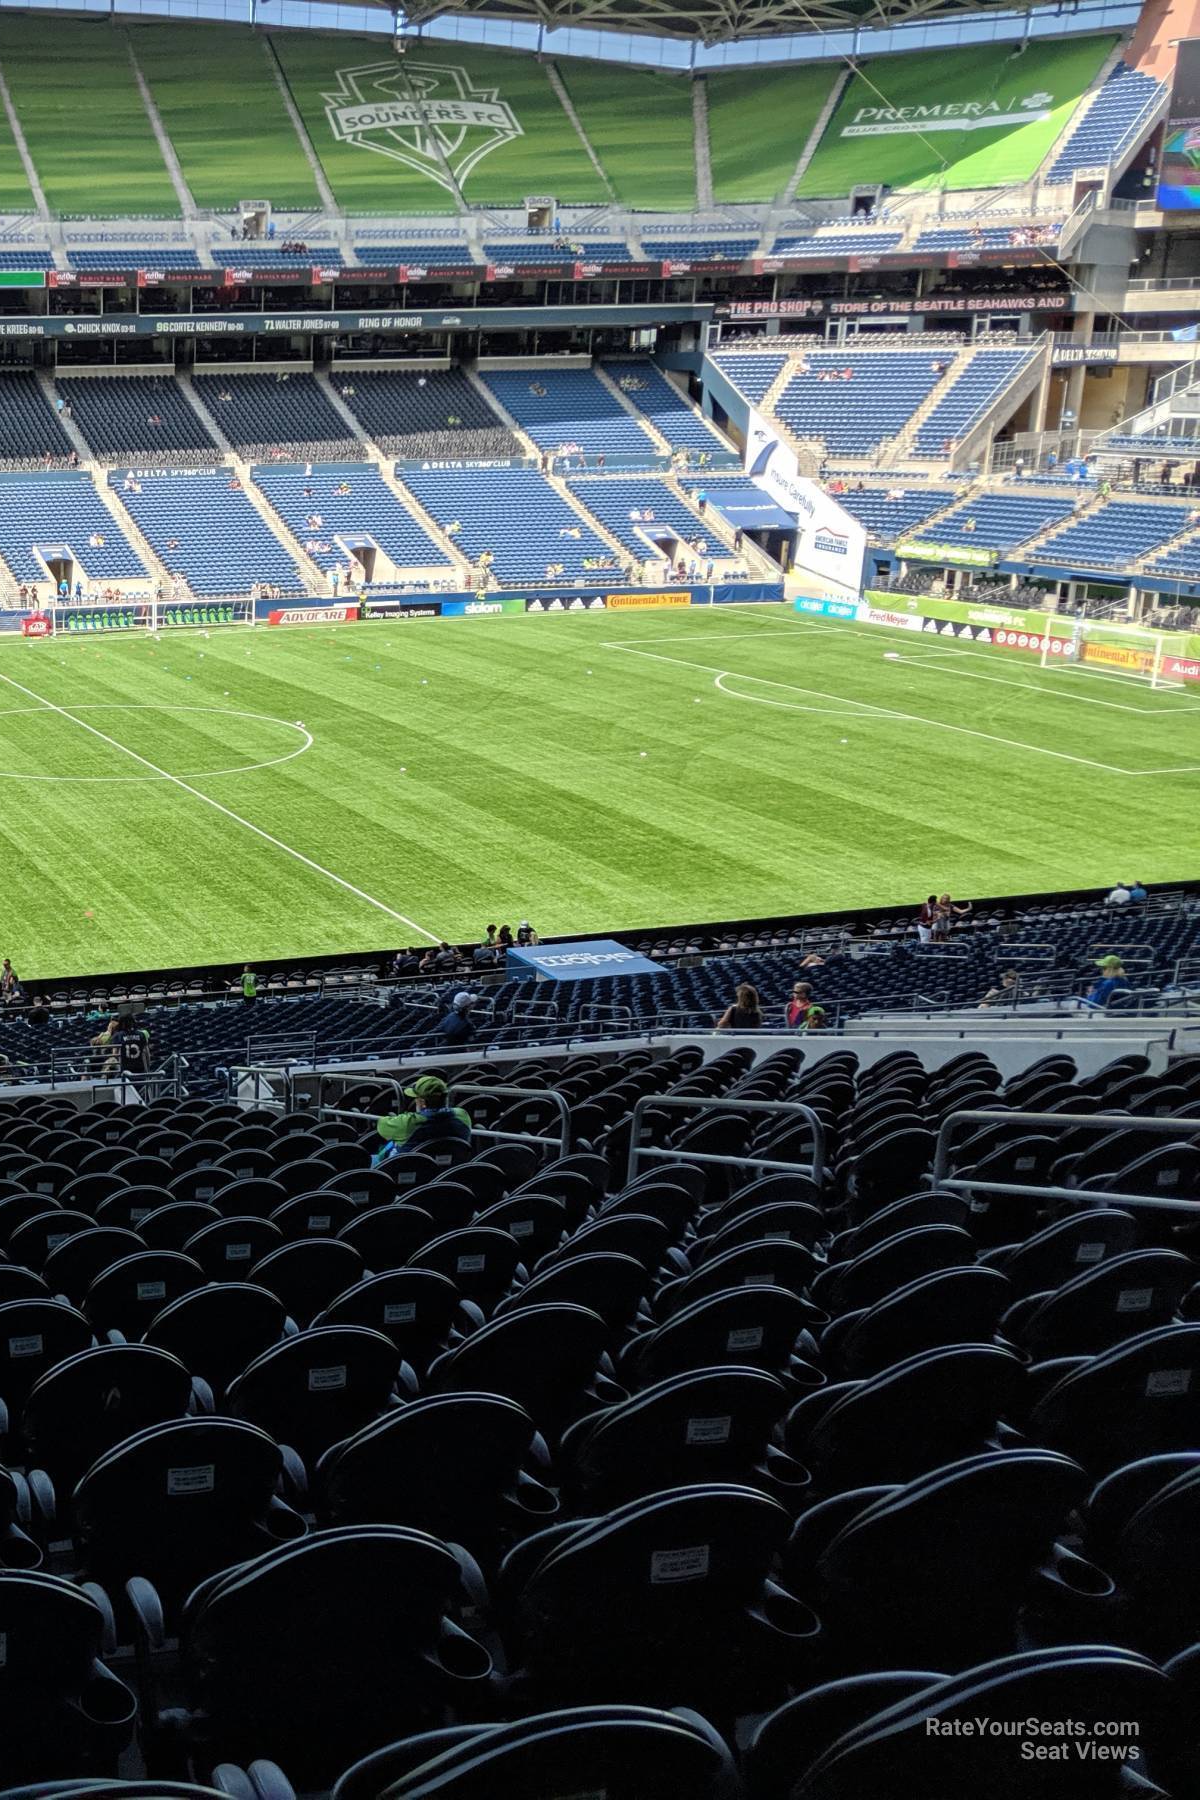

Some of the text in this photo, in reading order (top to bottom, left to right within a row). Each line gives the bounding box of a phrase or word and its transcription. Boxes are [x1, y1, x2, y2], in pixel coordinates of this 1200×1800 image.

[852, 100, 1001, 123] PREMERA
[475, 112, 503, 124] FC
[729, 301, 811, 314] THE PRO SHOP
[830, 297, 1065, 313] STORE OF THE SEATTLE SEAHAWKS AND
[77, 324, 100, 334] CHUCK
[101, 323, 120, 333] KNOX
[156, 322, 169, 333] 96
[169, 322, 194, 332] CORTEZ
[195, 322, 227, 332] KENNEDY
[264, 320, 275, 330] 71
[275, 320, 300, 330] WALTER
[301, 319, 324, 329] JONES
[359, 317, 422, 328] RING OF HONOR
[6, 324, 28, 334] KRIEG
[432, 461, 462, 469] DELTA
[770, 469, 816, 519] Insure Carefully
[610, 594, 688, 608] Continental TIRE
[385, 609, 408, 619] Imaging
[409, 608, 435, 618] Systems
[464, 602, 503, 615] slalom
[281, 609, 345, 623] ADVOCARE
[1171, 662, 1199, 675] Audi
